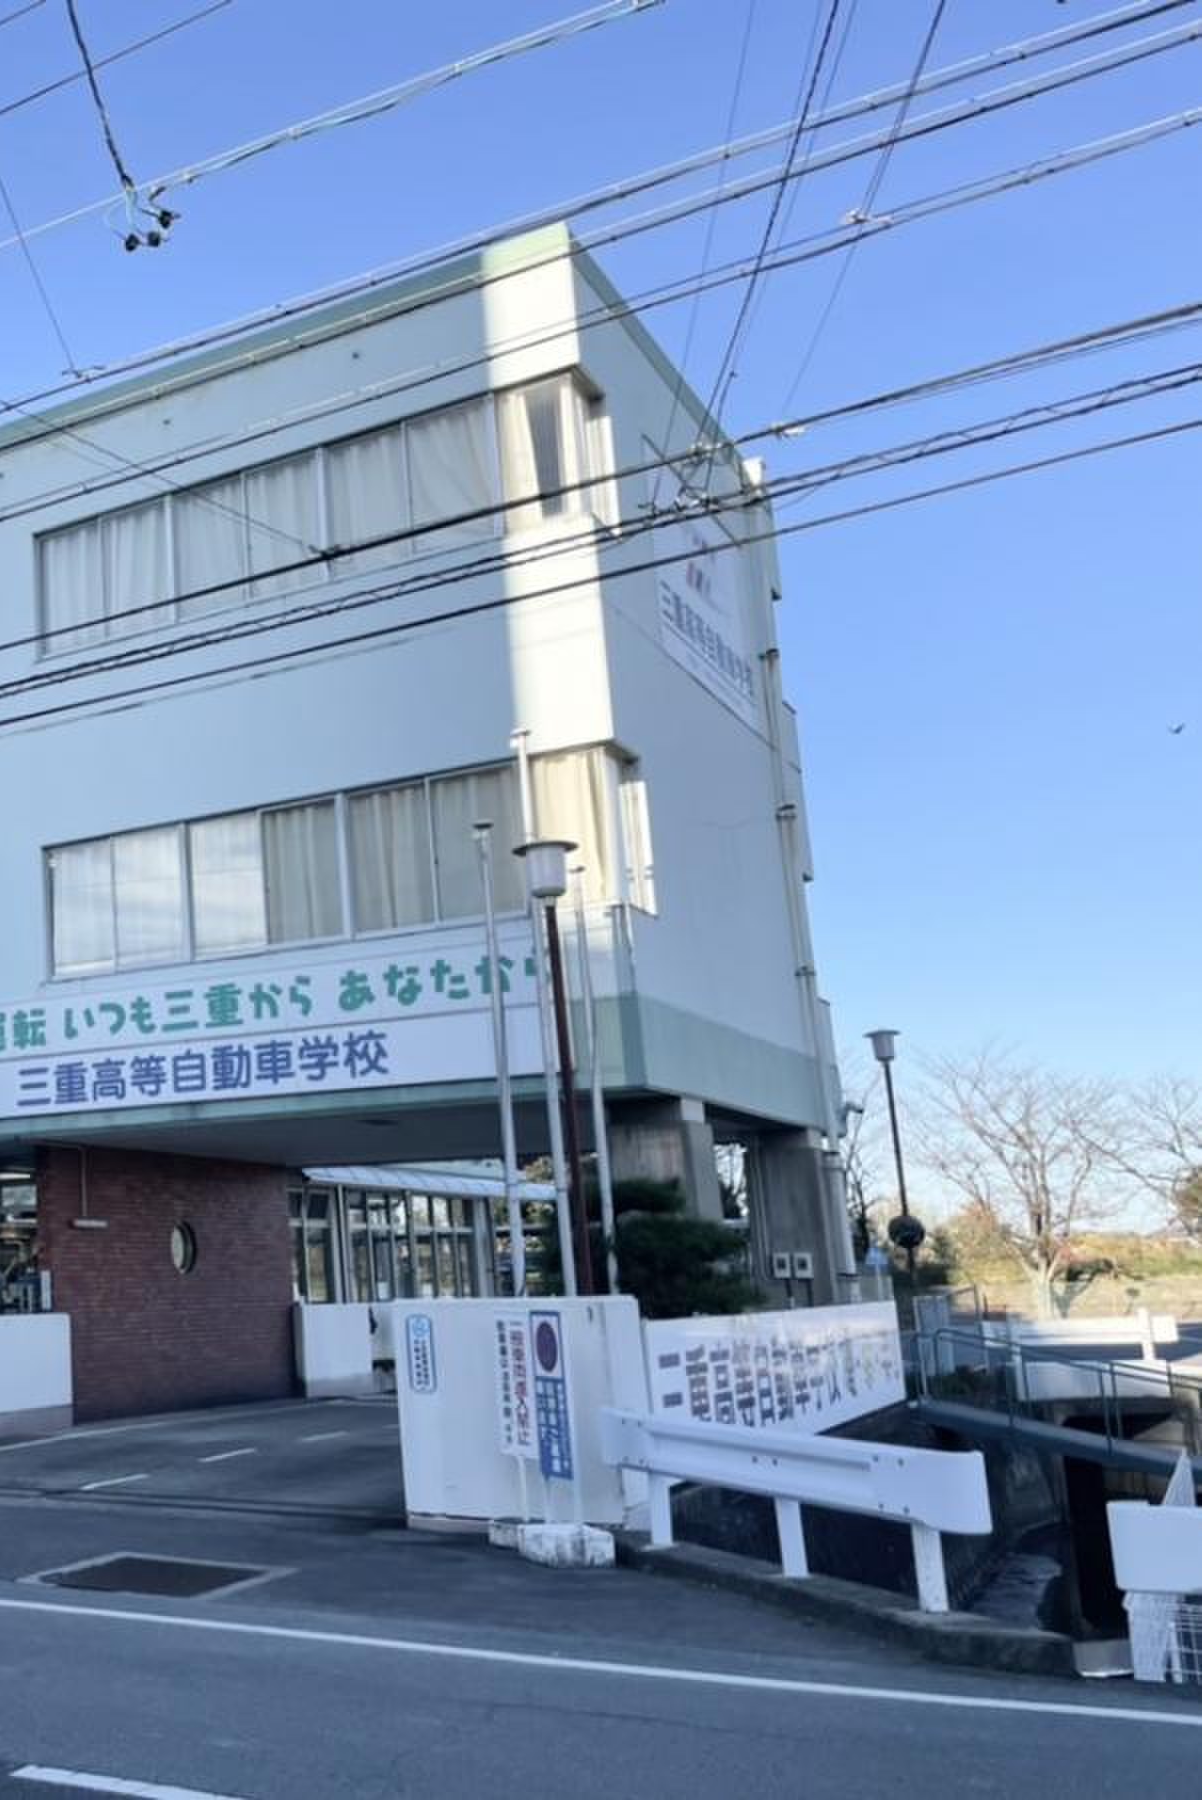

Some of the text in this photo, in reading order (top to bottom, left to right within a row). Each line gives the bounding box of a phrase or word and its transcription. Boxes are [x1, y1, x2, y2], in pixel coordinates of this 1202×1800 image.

[63, 974, 312, 1040] いつも三重から
[338, 954, 538, 1013] あなたか
[16, 1030, 390, 1109] 三重高等自動車学校
